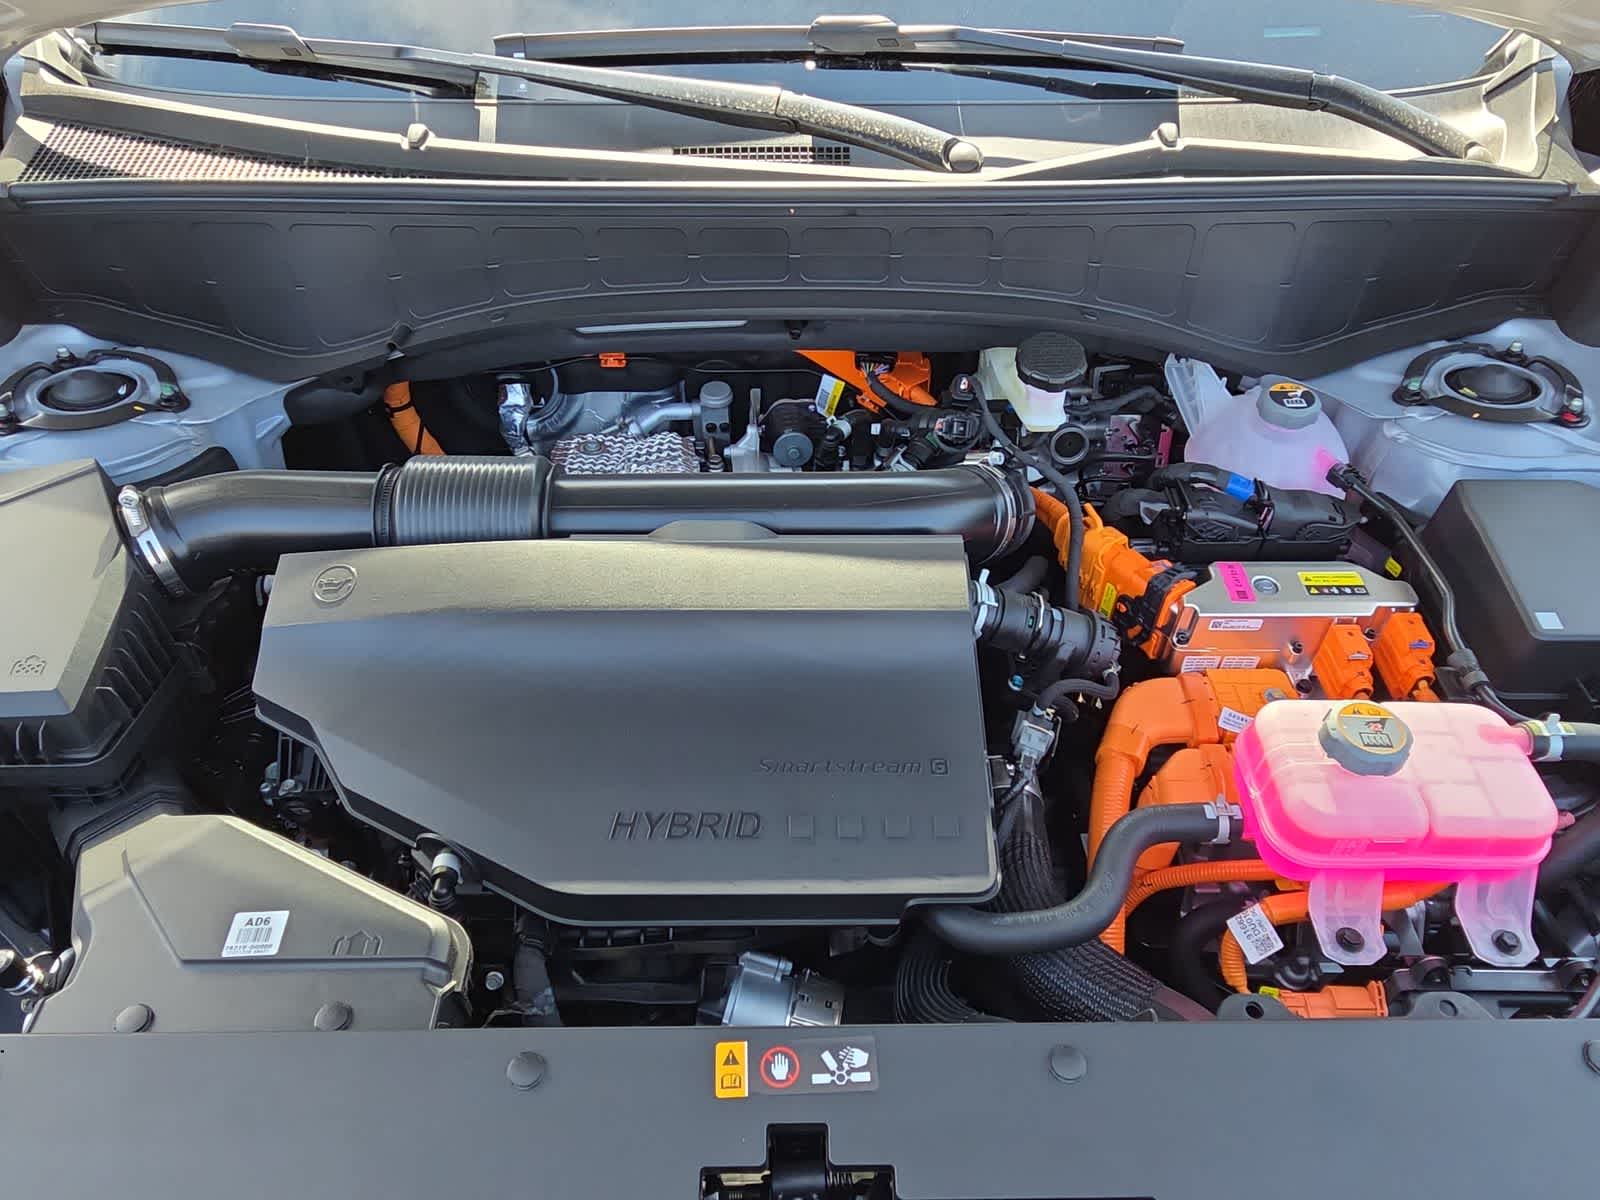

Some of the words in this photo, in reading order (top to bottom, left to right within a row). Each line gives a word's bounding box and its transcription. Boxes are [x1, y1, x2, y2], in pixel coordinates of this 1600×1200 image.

[760, 758, 922, 776] Smartstream
[608, 811, 762, 840] HYBRID
[245, 917, 271, 927] AD6
